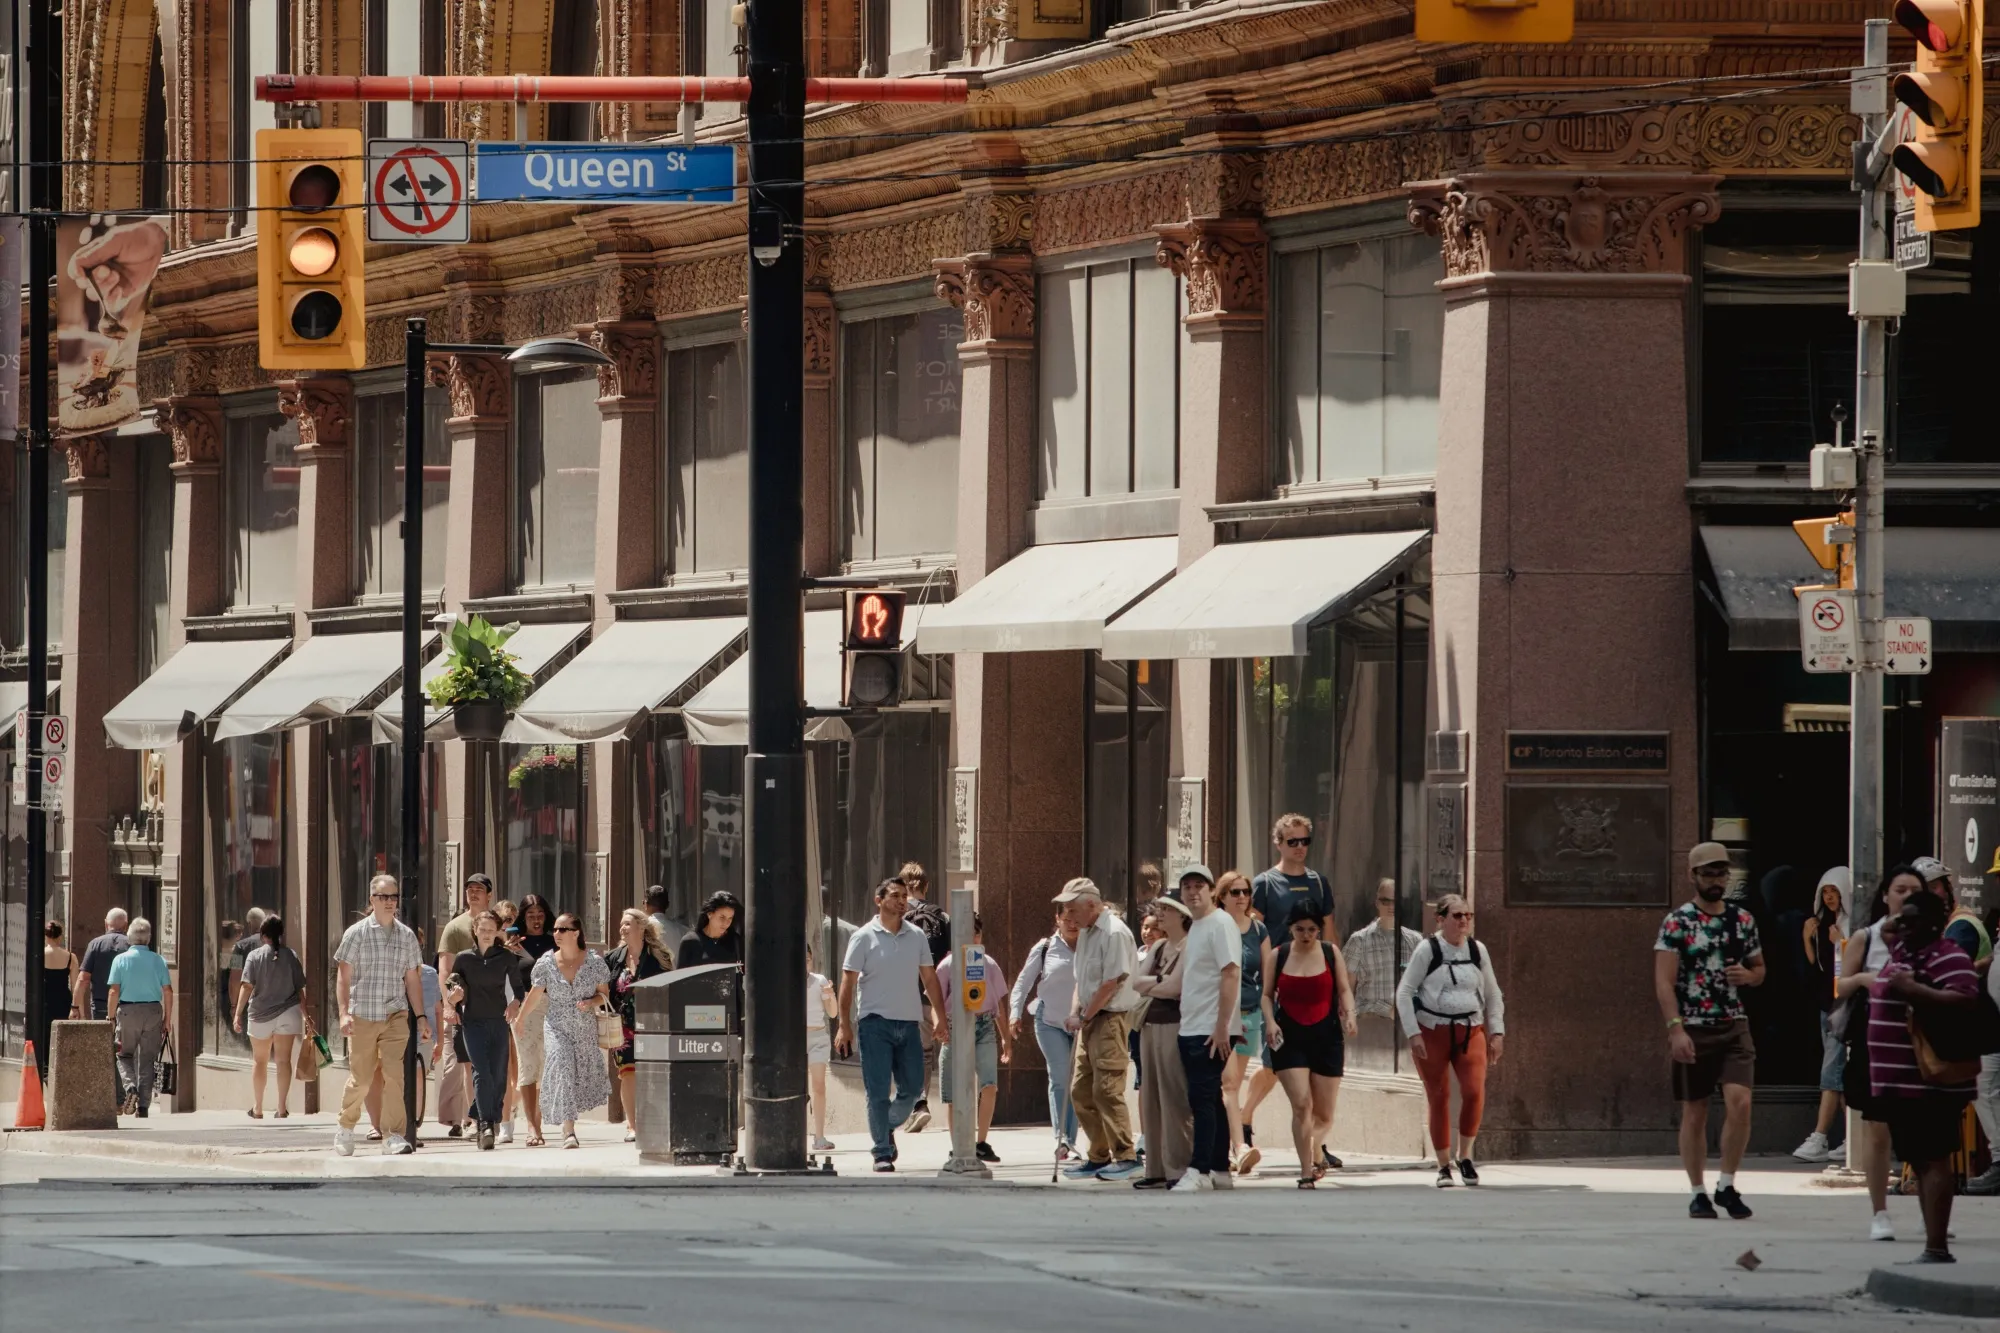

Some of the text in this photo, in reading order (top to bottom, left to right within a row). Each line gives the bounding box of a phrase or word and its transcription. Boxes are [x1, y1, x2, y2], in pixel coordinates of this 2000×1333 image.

[1560, 116, 1616, 151] QUEEN
[524, 150, 687, 192] Queen St
[1899, 624, 1914, 637] NO
[1887, 641, 1927, 654] STANDING
[1514, 746, 1664, 758] CF Toronto Eaton Centre
[678, 1039, 709, 1053] Litter
